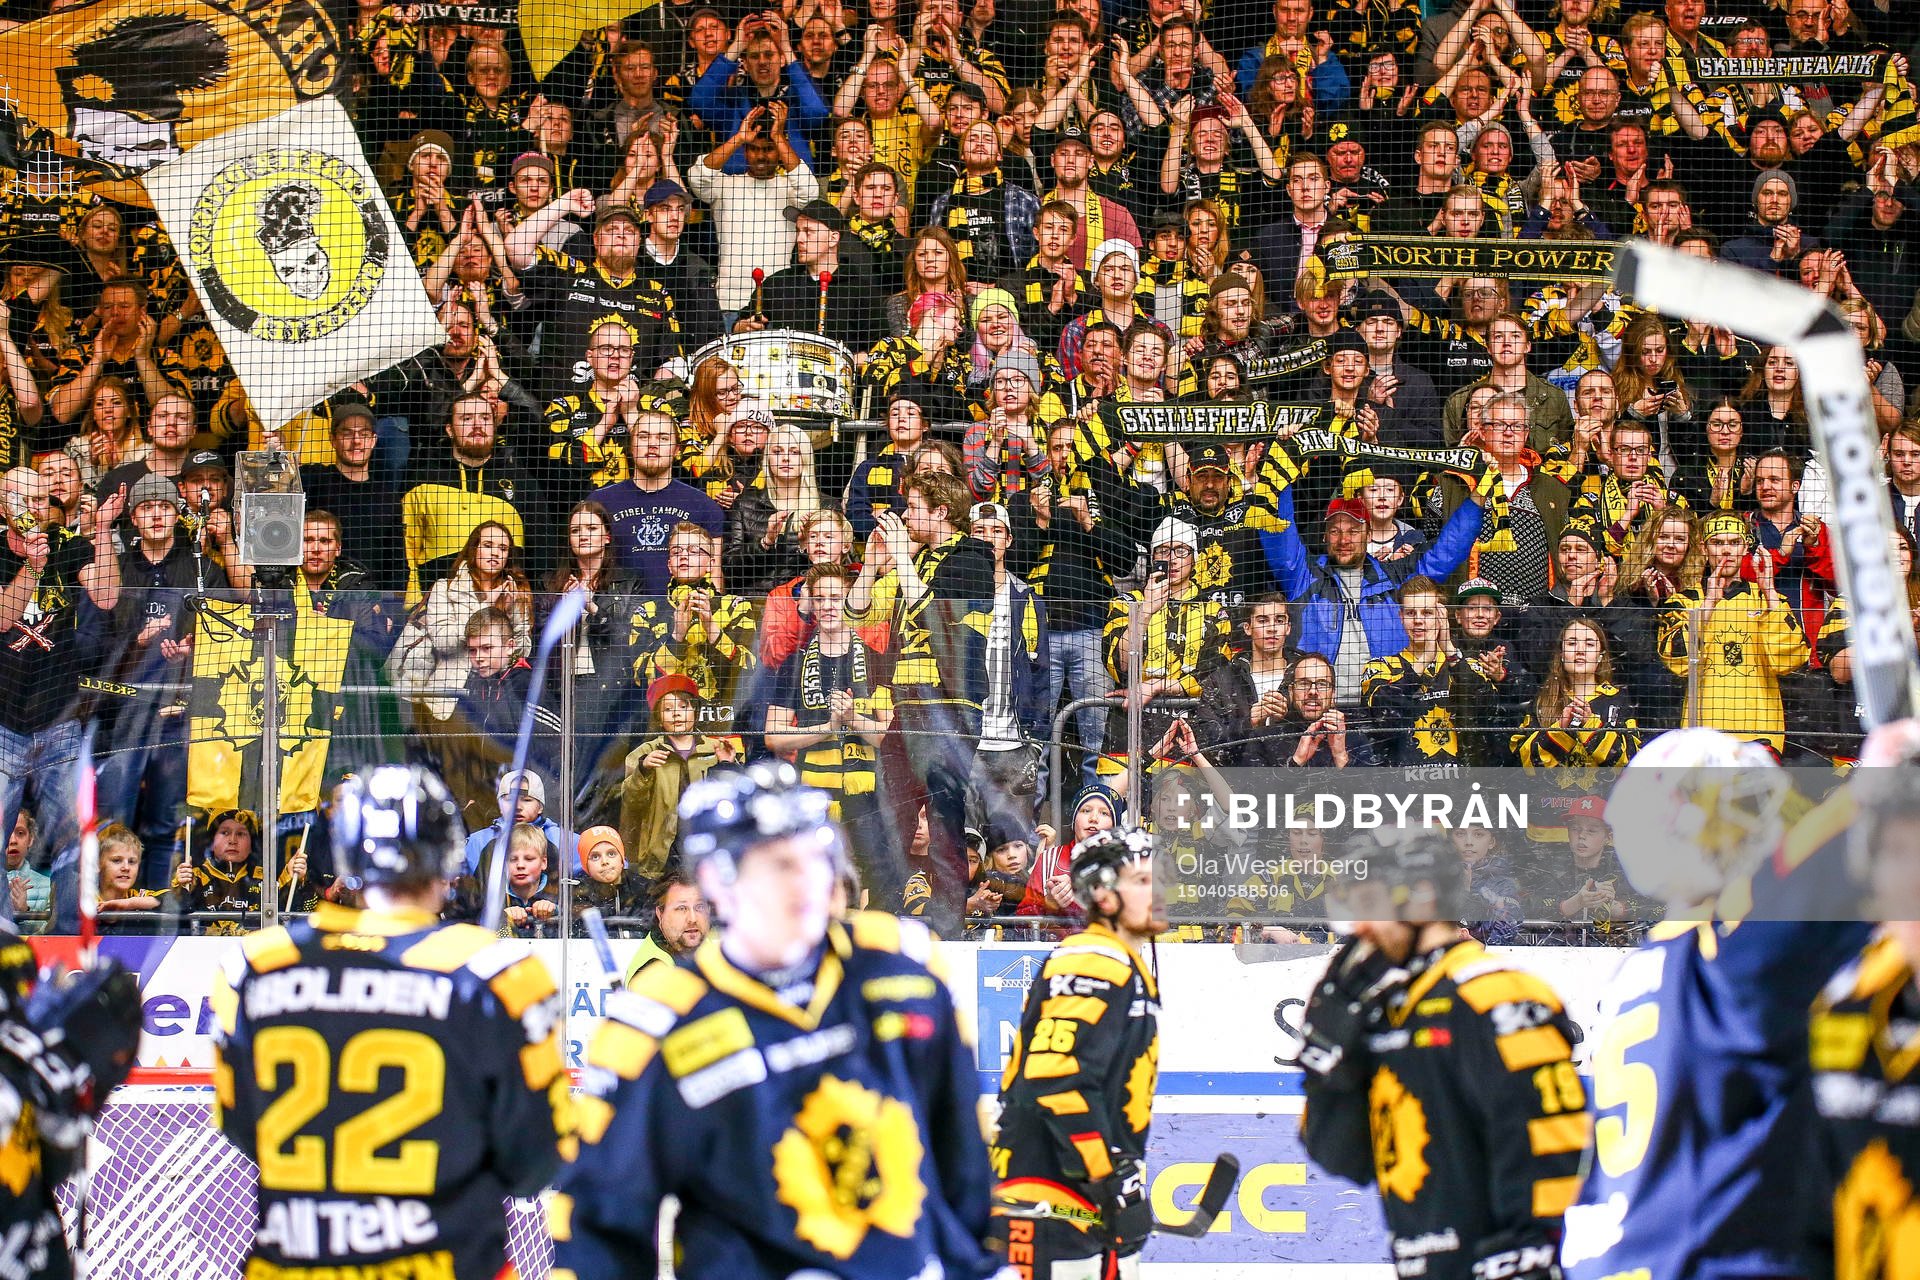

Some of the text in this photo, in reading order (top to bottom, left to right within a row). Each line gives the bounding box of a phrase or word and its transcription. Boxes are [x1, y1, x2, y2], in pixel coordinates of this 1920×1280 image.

[1833, 54, 1875, 75] AIK
[1369, 245, 1479, 267] NORTH
[1491, 249, 1616, 272] POWER
[1121, 402, 1268, 433] SKELLEFTEÅ
[613, 506, 691, 522] ETIREL CAMPUS
[252, 1025, 446, 1195] 22
